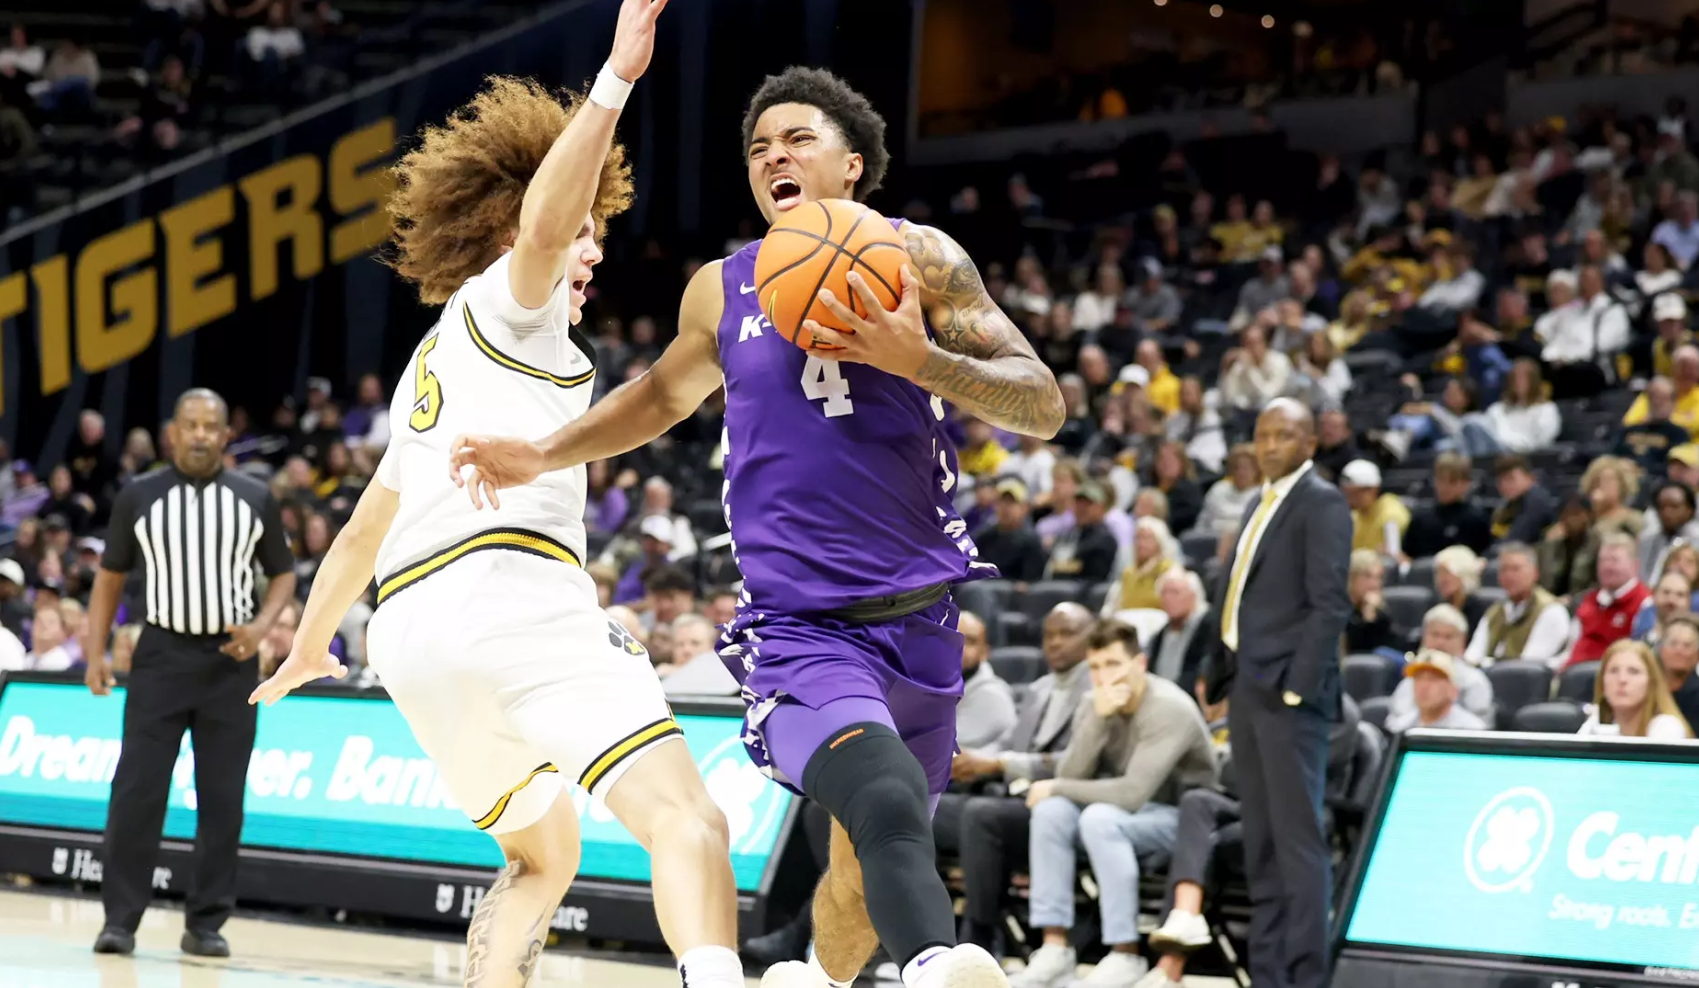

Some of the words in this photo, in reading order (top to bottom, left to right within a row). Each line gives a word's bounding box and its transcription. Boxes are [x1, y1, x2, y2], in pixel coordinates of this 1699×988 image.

[409, 332, 444, 433] 5
[800, 355, 854, 418] 4
[1569, 811, 1699, 884] Cent
